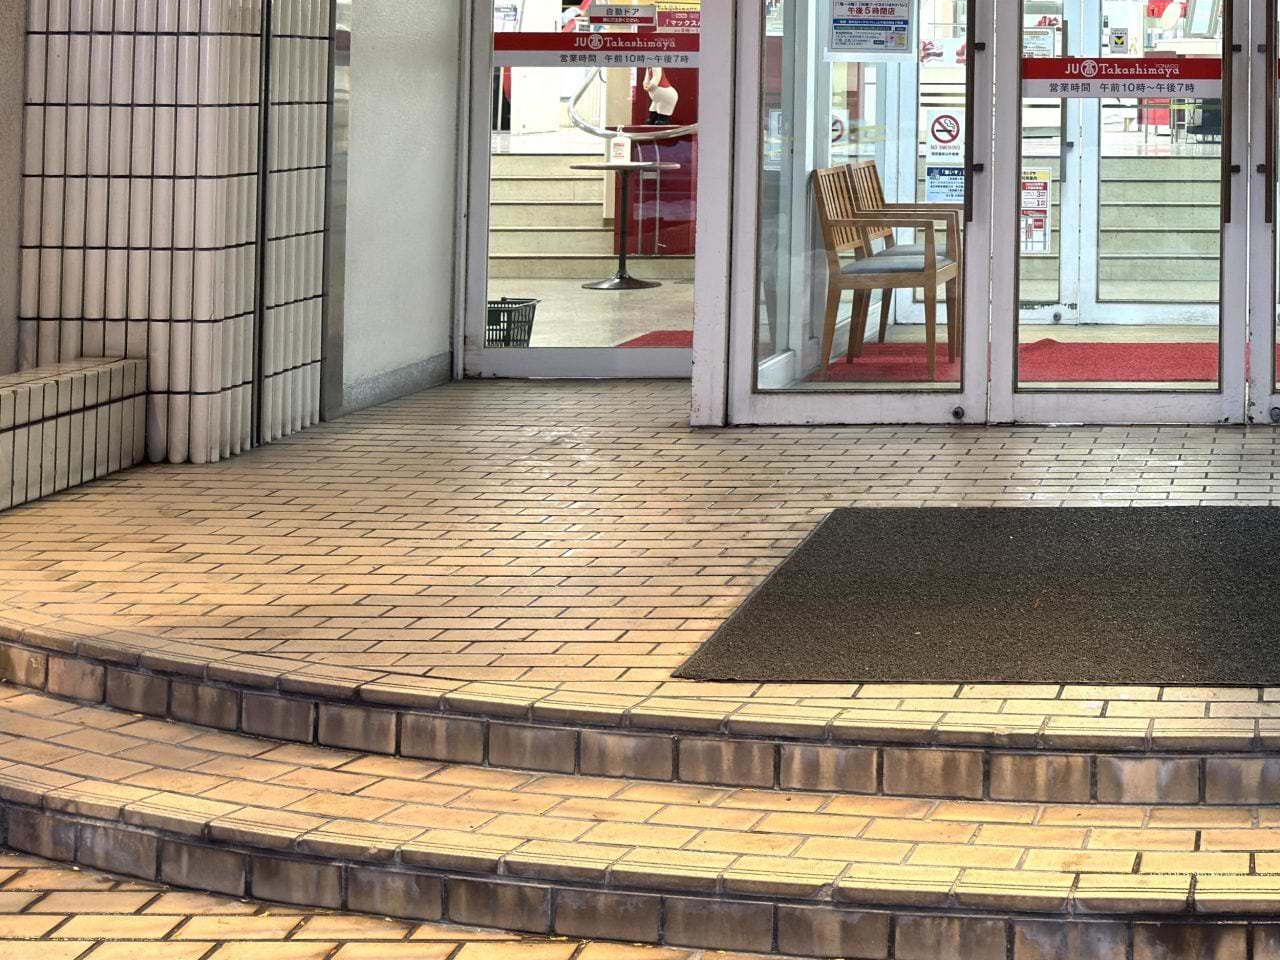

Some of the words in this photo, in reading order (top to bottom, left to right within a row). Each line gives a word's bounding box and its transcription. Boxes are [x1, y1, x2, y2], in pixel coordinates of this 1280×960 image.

[574, 38, 587, 48] JU
[605, 37, 676, 50] Takashimaya
[560, 54, 597, 63] 営業時間
[1064, 63, 1080, 74] JU
[1099, 63, 1180, 77] Takashimaya
[1049, 82, 1091, 92] 営業時間
